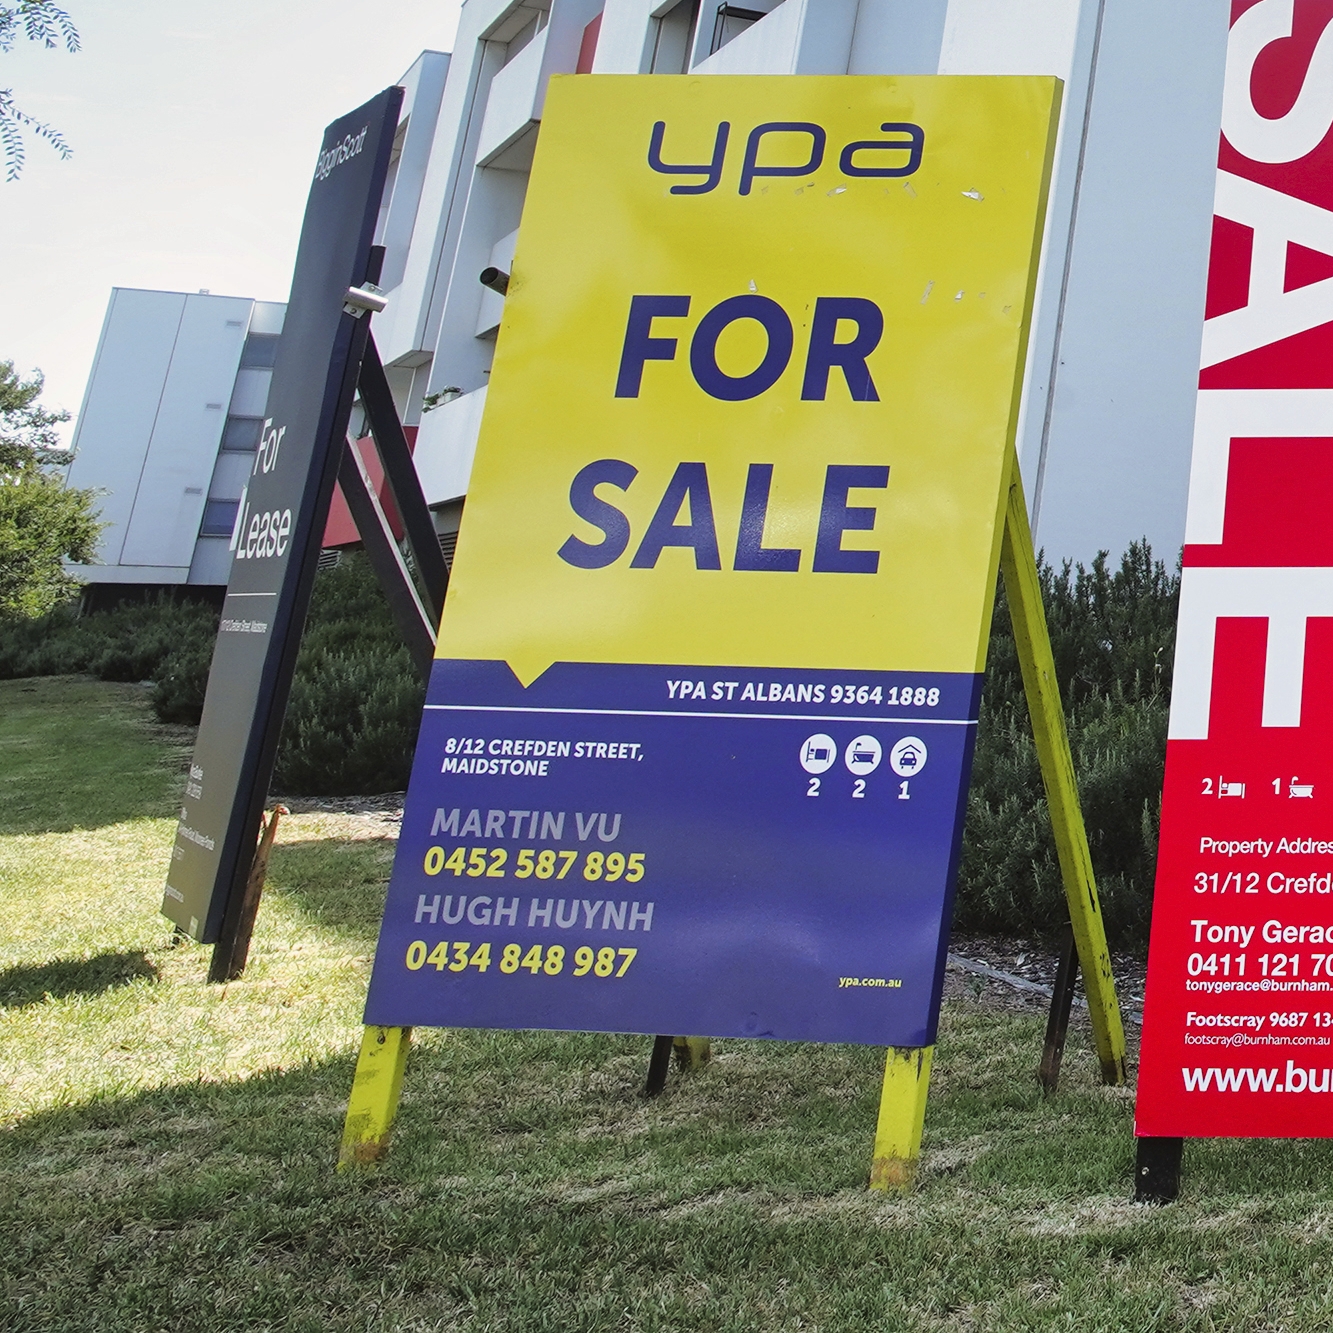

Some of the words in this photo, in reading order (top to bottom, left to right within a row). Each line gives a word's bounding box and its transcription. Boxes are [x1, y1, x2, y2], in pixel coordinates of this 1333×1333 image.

[647, 121, 925, 196] ypa
[614, 294, 884, 402] FOR
[253, 417, 287, 476] For
[556, 458, 891, 574] SALE
[236, 502, 292, 560] Lease
[666, 680, 707, 700] YPA
[711, 681, 739, 700] ST
[740, 682, 826, 703] ALBANS
[830, 684, 883, 705] 9364
[887, 686, 940, 707] 1888
[445, 737, 485, 755] 8/12
[488, 739, 571, 757] CREFDEN
[573, 741, 644, 761] STREET,
[441, 757, 550, 776] MAIDSTONE
[807, 777, 821, 797] 2
[852, 779, 866, 798] 2
[898, 781, 911, 800] 1
[1201, 778, 1213, 795] 2
[1271, 778, 1281, 795] 1
[430, 808, 566, 840] MARTIN
[575, 812, 622, 842] VU
[1199, 837, 1274, 858] Property
[424, 846, 508, 878] 0452
[514, 849, 578, 879] 587
[583, 851, 646, 883] 895
[1193, 871, 1260, 894] 31/12
[414, 894, 520, 926] HUGH
[527, 898, 655, 931] HUYNH
[1190, 919, 1256, 948] Tony
[406, 940, 491, 972] 0434
[500, 943, 565, 975] 848
[573, 946, 638, 978] 987
[1187, 952, 1246, 976] 0411
[1258, 953, 1300, 976] 121
[838, 977, 902, 988] ypa.com.au
[1186, 1011, 1266, 1032] Footscray
[1269, 1012, 1309, 1027] 9687
[1184, 1032, 1331, 1048] footscray@burnham.com.au
